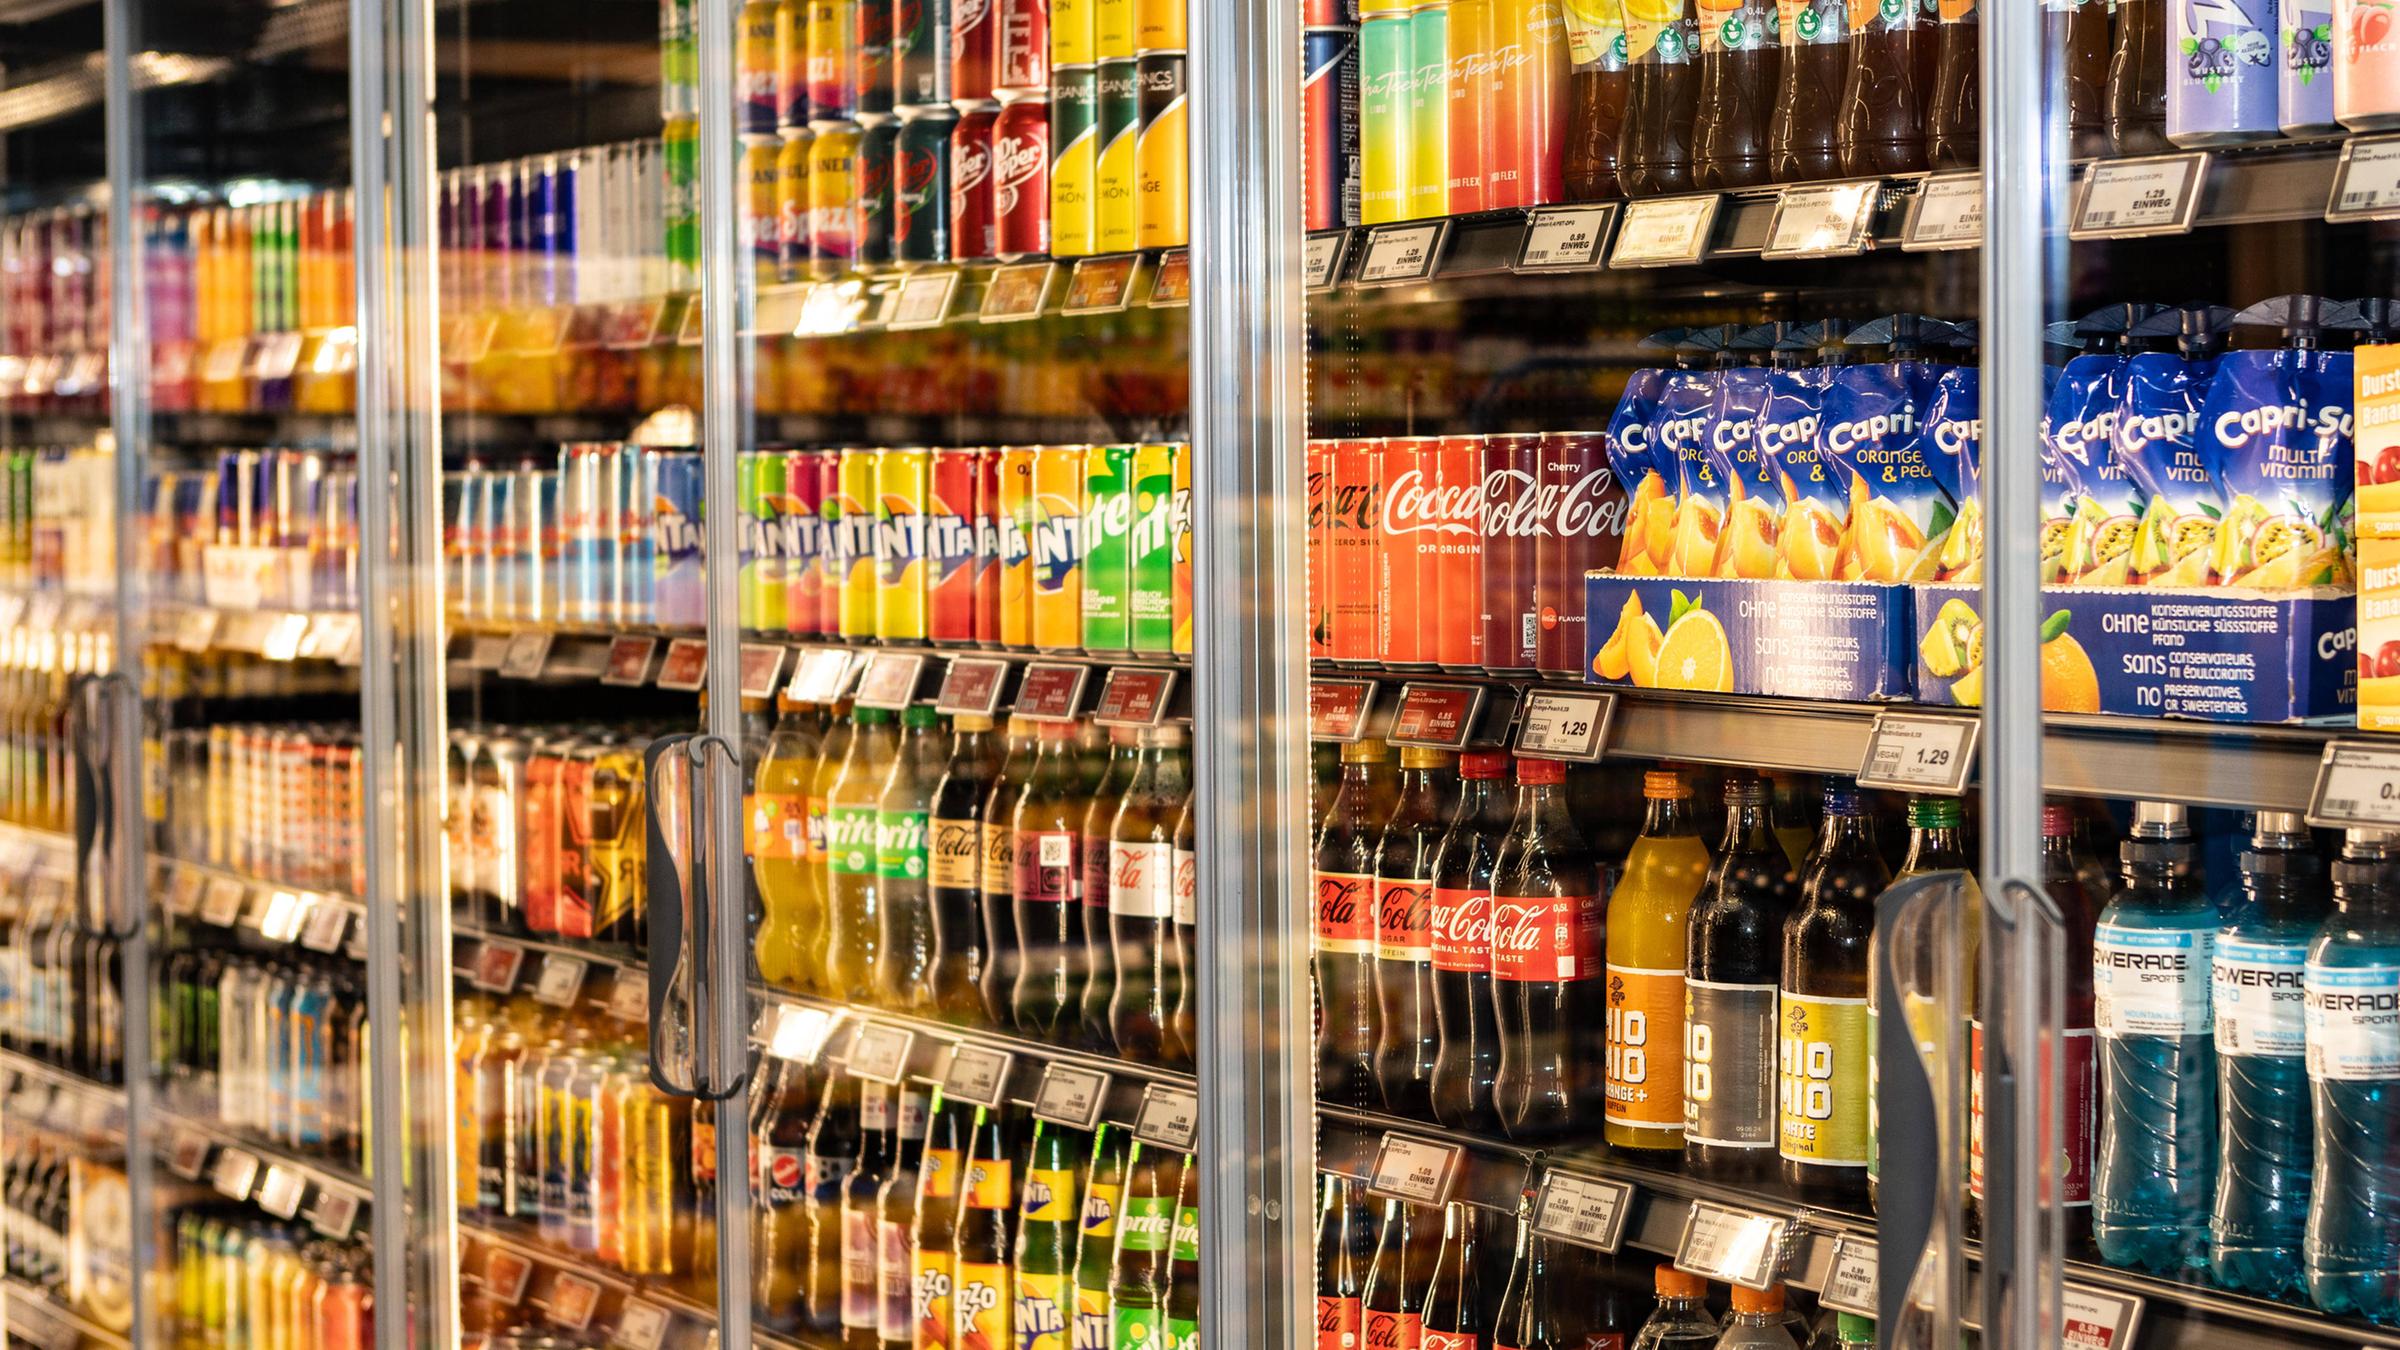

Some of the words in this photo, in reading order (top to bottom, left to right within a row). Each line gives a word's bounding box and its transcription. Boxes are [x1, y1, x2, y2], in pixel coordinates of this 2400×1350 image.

[1747, 7, 1766, 16] 0,4L
[1500, 169, 1518, 182] FLEX
[1461, 175, 1482, 188] FLEX
[2145, 189, 2166, 200] 1.29
[2132, 198, 2172, 209] EINWEG
[1569, 233, 1586, 241] 0.99
[1560, 241, 1590, 250] EINWEG
[1396, 255, 1422, 265] EINWEG
[1548, 461, 1581, 473] Cherry
[1810, 464, 1825, 482] &
[1882, 466, 1897, 482] &
[1440, 544, 1481, 555] ORIGIN
[2122, 653, 2167, 675] sans
[2136, 685, 2162, 706] no
[1324, 713, 1350, 722] EINWEG
[1437, 711, 1453, 720] 0.85
[1428, 719, 1456, 729] EINWEG
[1528, 722, 1548, 732] VEGAN
[1560, 720, 1588, 736] 1.29
[1876, 749, 1900, 760] VEGAN
[1917, 748, 1949, 765] 1.29
[1496, 953, 1525, 963] TASTE
[2140, 973, 2186, 984] SPORTS
[1783, 1119, 1817, 1141] MATE
[1418, 1166, 1432, 1176] 1.09
[1408, 1173, 1436, 1186] EINWEG
[1579, 1208, 1608, 1222] MEHRWEG
[1839, 1270, 1872, 1284] MEHRWEG
[2066, 1329, 2107, 1347] EINWEG
